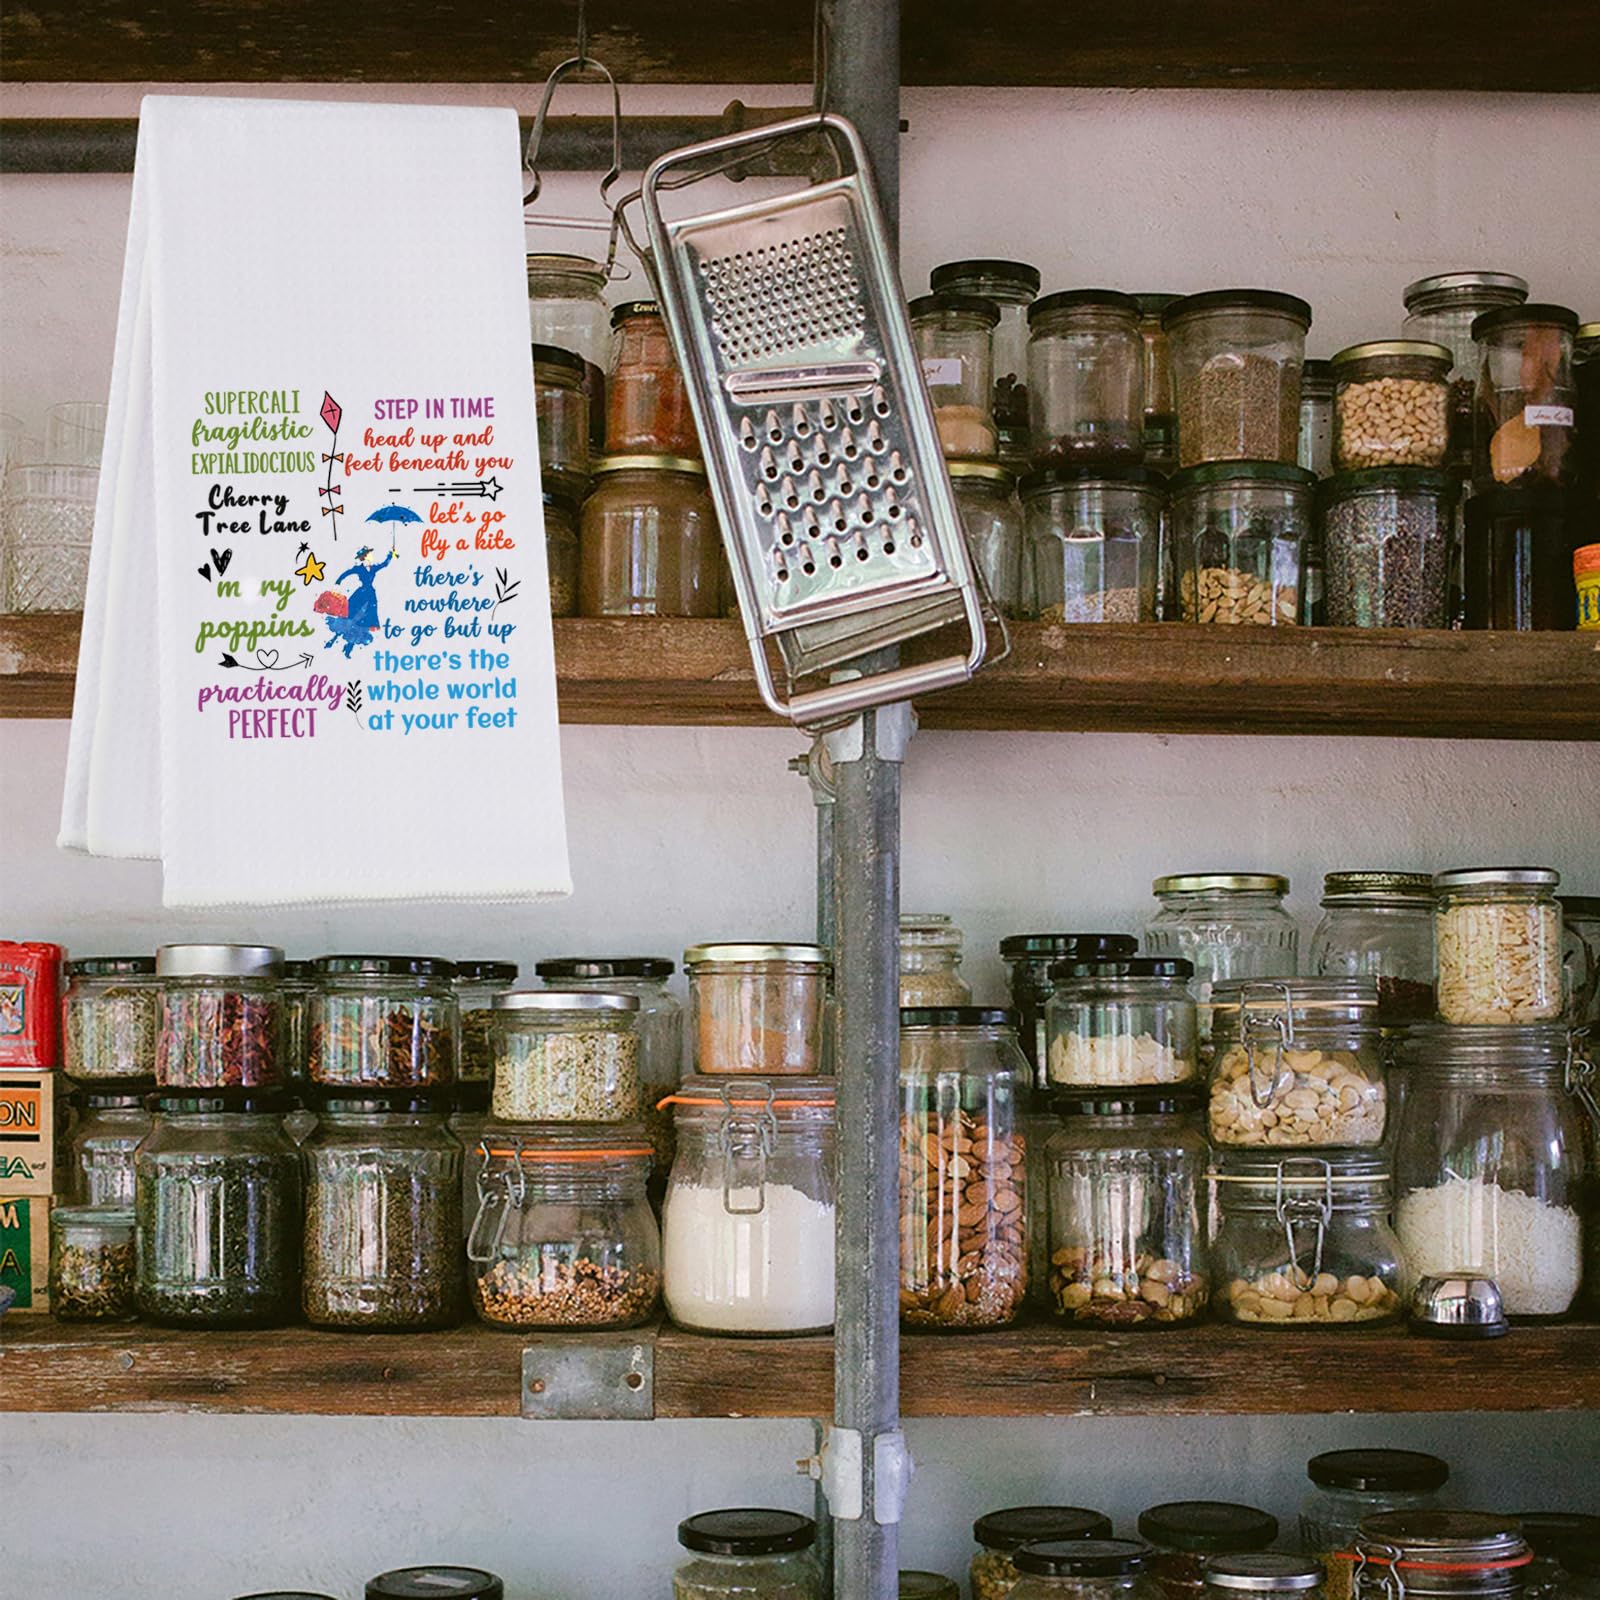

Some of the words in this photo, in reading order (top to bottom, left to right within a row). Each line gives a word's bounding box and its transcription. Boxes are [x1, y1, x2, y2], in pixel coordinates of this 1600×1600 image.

[204, 389, 300, 416] SUPERCALI
[374, 398, 419, 421] STEP
[425, 398, 445, 419] IN
[449, 396, 495, 419] TIME
[191, 415, 314, 451] fragilistic
[363, 426, 415, 449] head
[420, 433, 448, 453] up
[452, 425, 495, 447] and
[191, 450, 316, 475] EXPIALIDOCIOUS
[344, 451, 383, 477] feet
[388, 450, 470, 473] beneath
[474, 456, 514, 478] you
[207, 483, 290, 517] Cherry
[194, 510, 252, 537] Tree
[259, 510, 312, 536] Lane
[429, 501, 475, 525] let's
[480, 509, 506, 532] go
[420, 529, 452, 561] fly
[455, 538, 470, 551] a
[474, 528, 516, 551] kite
[413, 564, 485, 588] there's
[216, 577, 297, 612] mry
[404, 592, 495, 613] nowhere
[194, 612, 316, 654] poppins
[382, 618, 405, 640] to
[410, 624, 438, 647] go
[443, 616, 483, 639] but
[487, 623, 517, 645] up
[372, 649, 462, 674] there's
[468, 648, 510, 673] the
[197, 673, 347, 713] practically
[366, 677, 440, 704] whole
[446, 676, 517, 700] world
[228, 707, 318, 740] PERFECT
[367, 709, 395, 731] at
[401, 712, 460, 736] your
[465, 705, 518, 730] feet
